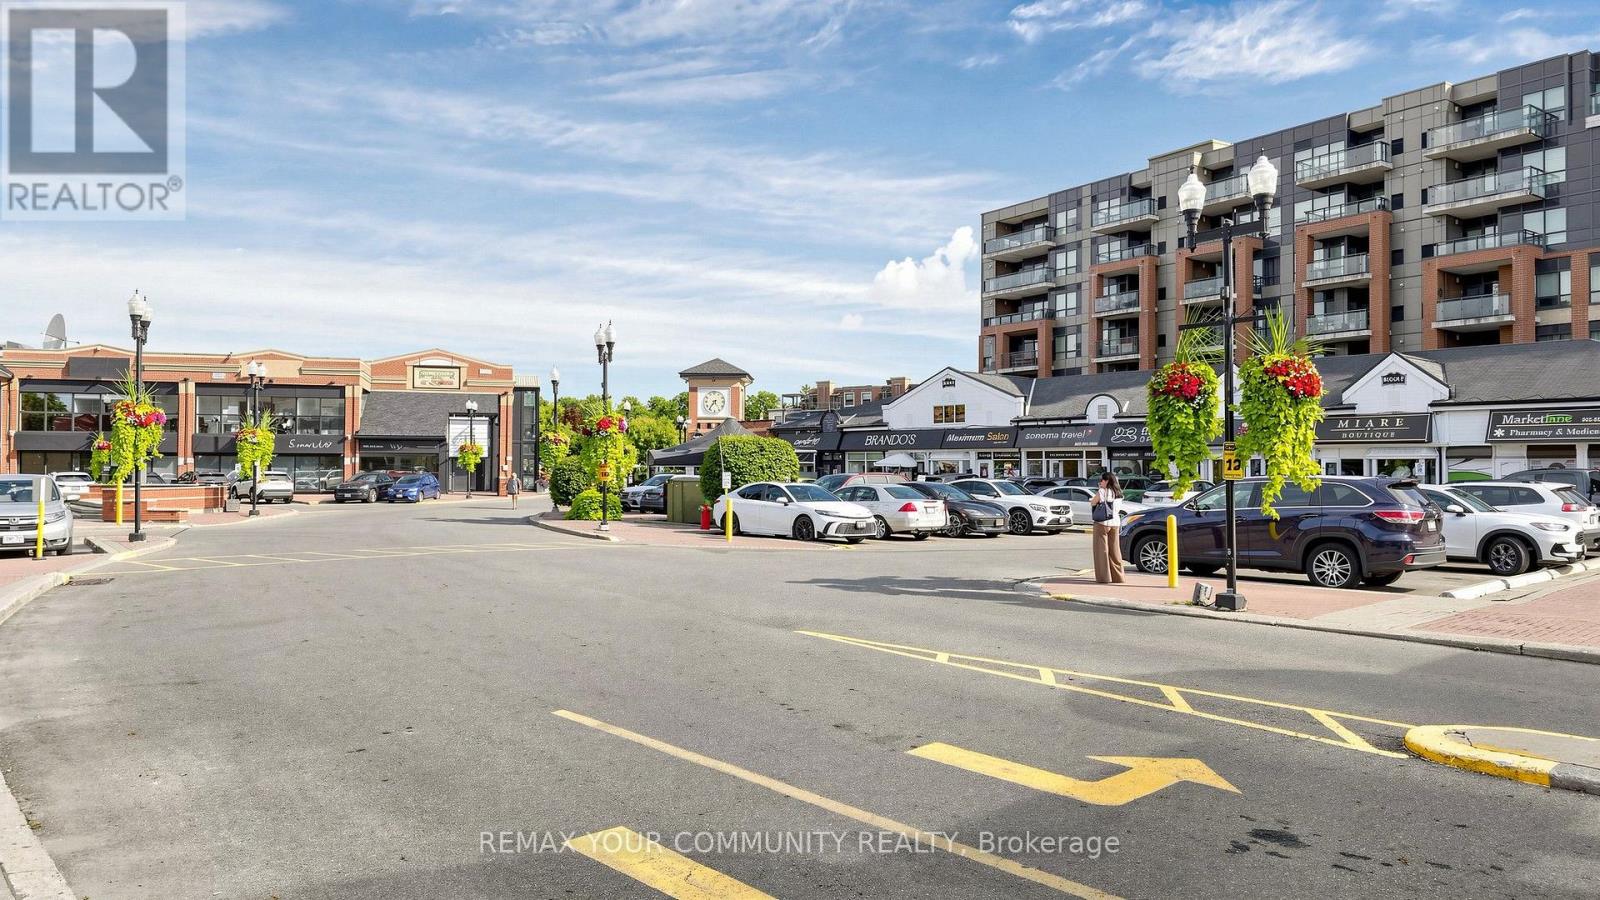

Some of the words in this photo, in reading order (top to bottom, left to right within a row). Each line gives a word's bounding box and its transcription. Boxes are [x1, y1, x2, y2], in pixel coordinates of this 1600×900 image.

[1337, 418, 1404, 428] MIARE
[946, 434, 985, 442] Maximum
[986, 431, 1009, 441] Salon
[1025, 432, 1059, 440] sonoma
[1061, 429, 1086, 439] travel
[1341, 431, 1396, 439] BOUTIQUE
[1509, 428, 1553, 437] Pharmacy
[864, 433, 917, 446] BRANDO'S
